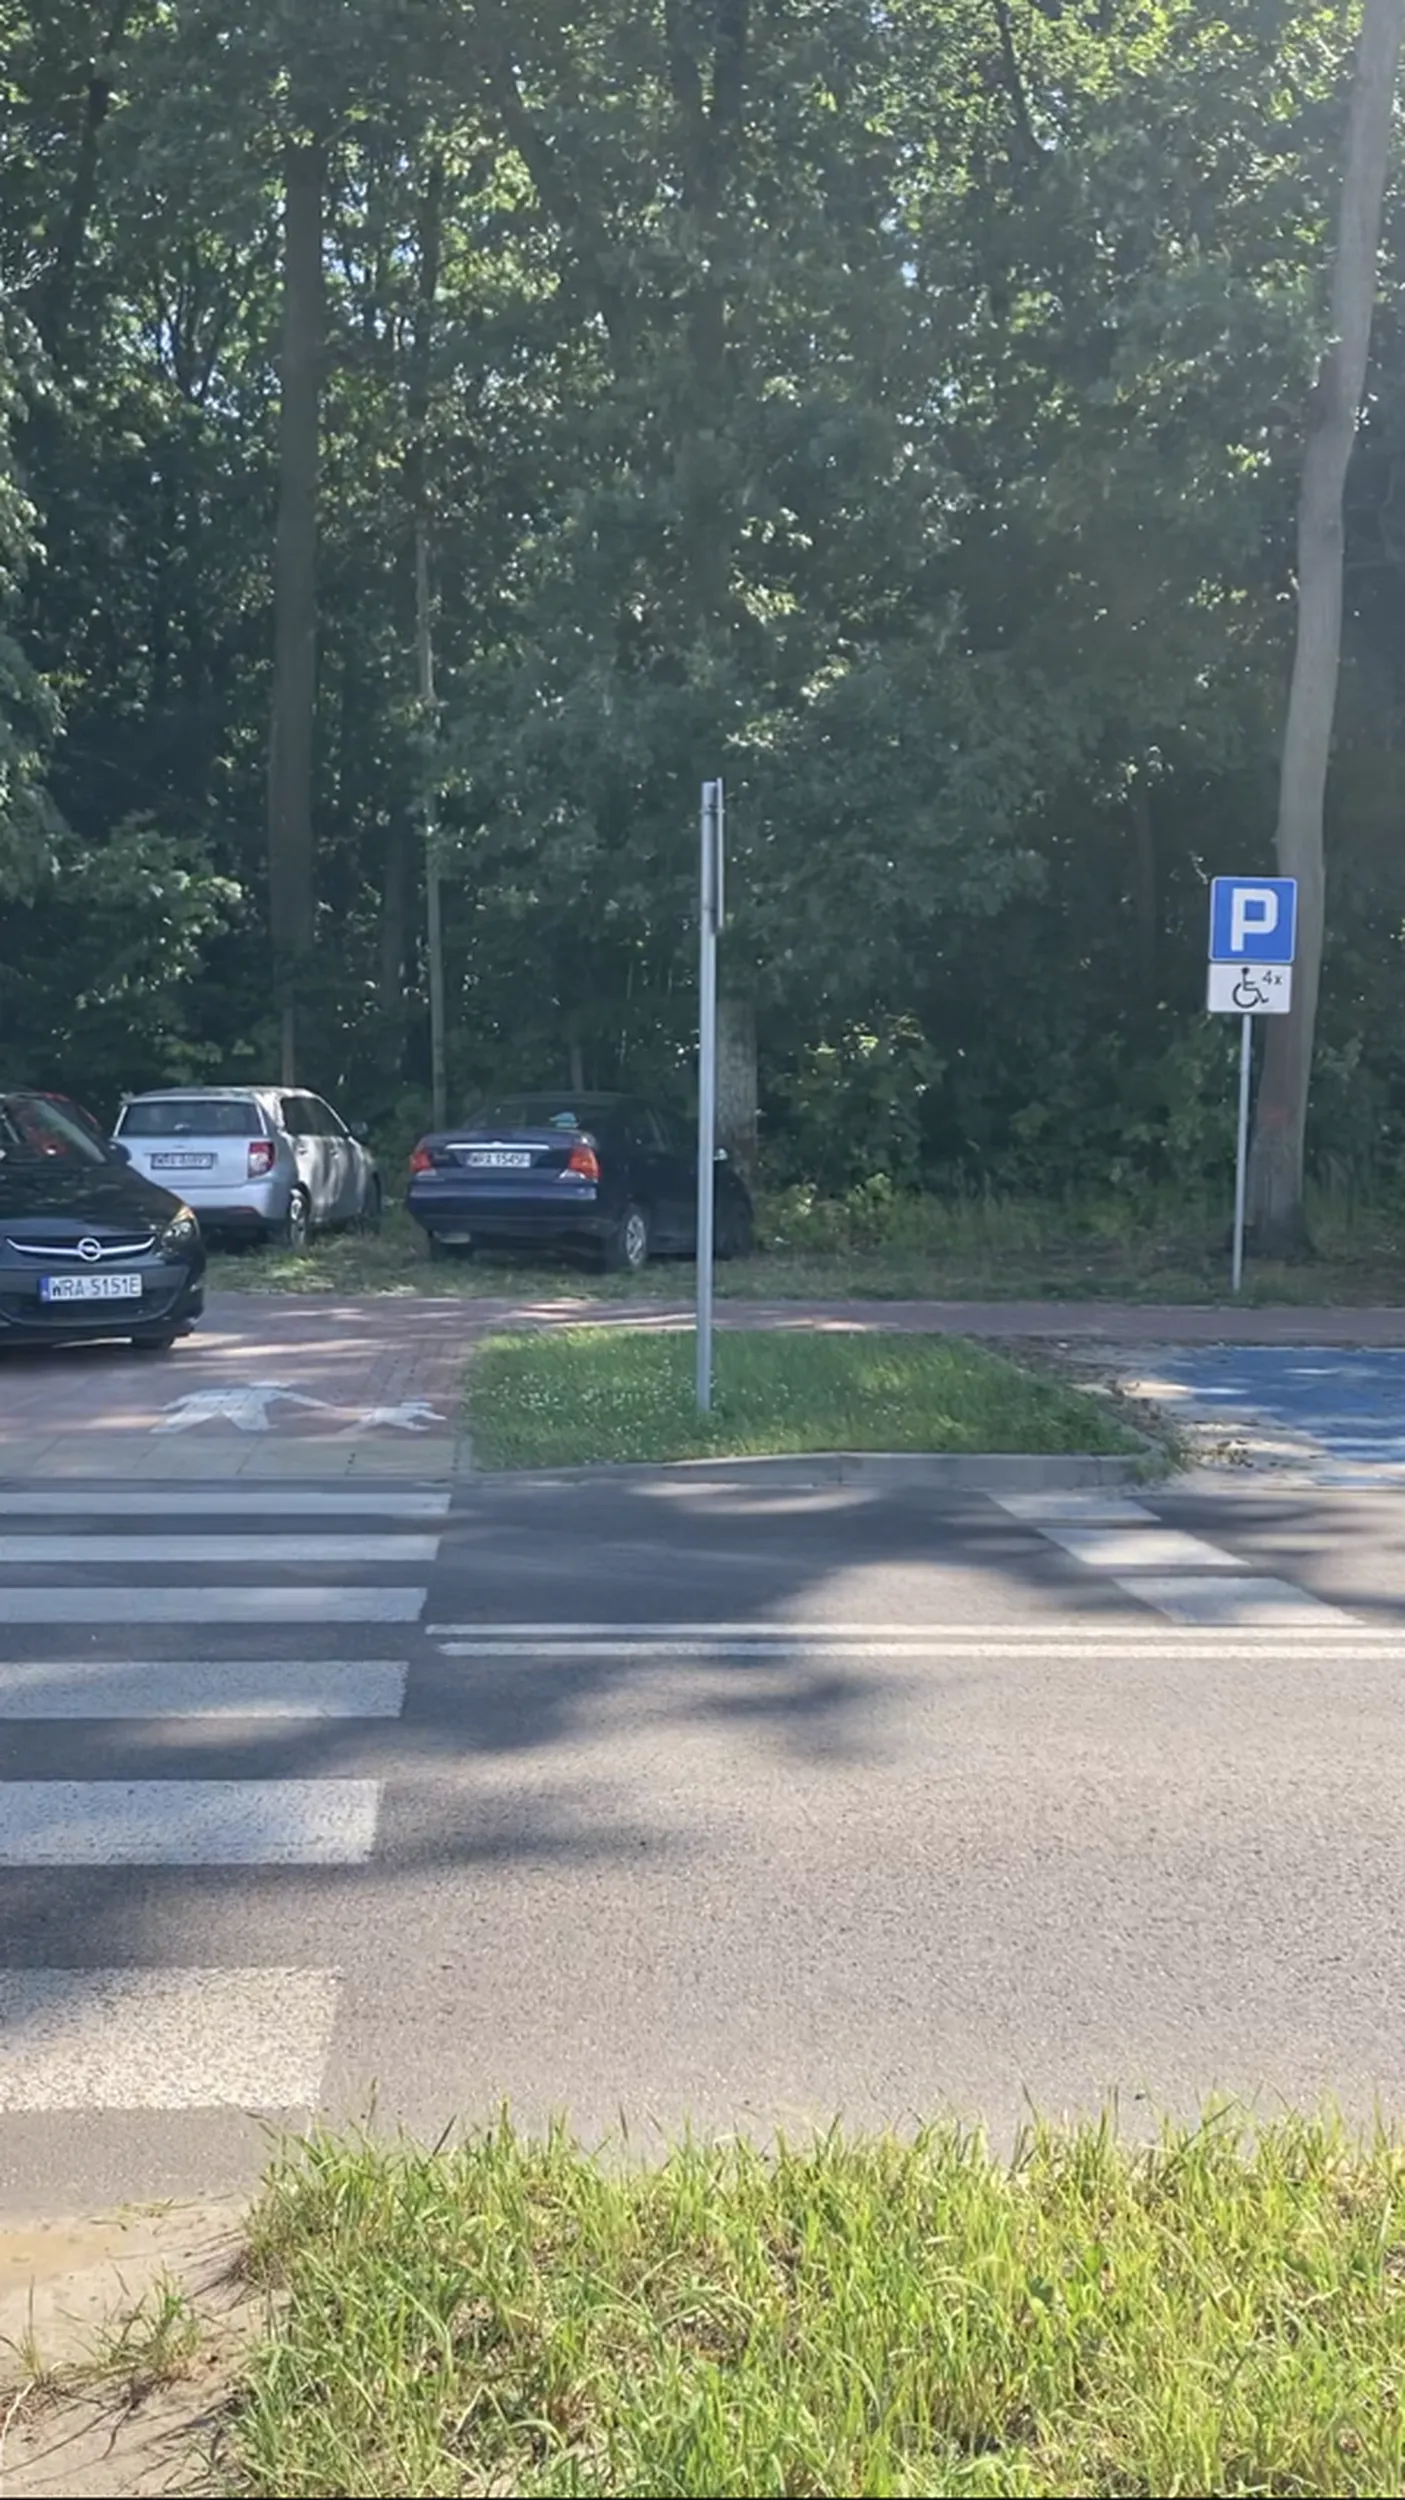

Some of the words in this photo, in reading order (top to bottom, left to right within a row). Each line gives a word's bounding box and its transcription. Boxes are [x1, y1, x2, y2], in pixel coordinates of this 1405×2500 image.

[1231, 888, 1278, 952] P
[1262, 970, 1282, 985] 4x
[52, 1279, 84, 1297] WRA
[91, 1277, 138, 1296] 5151E
